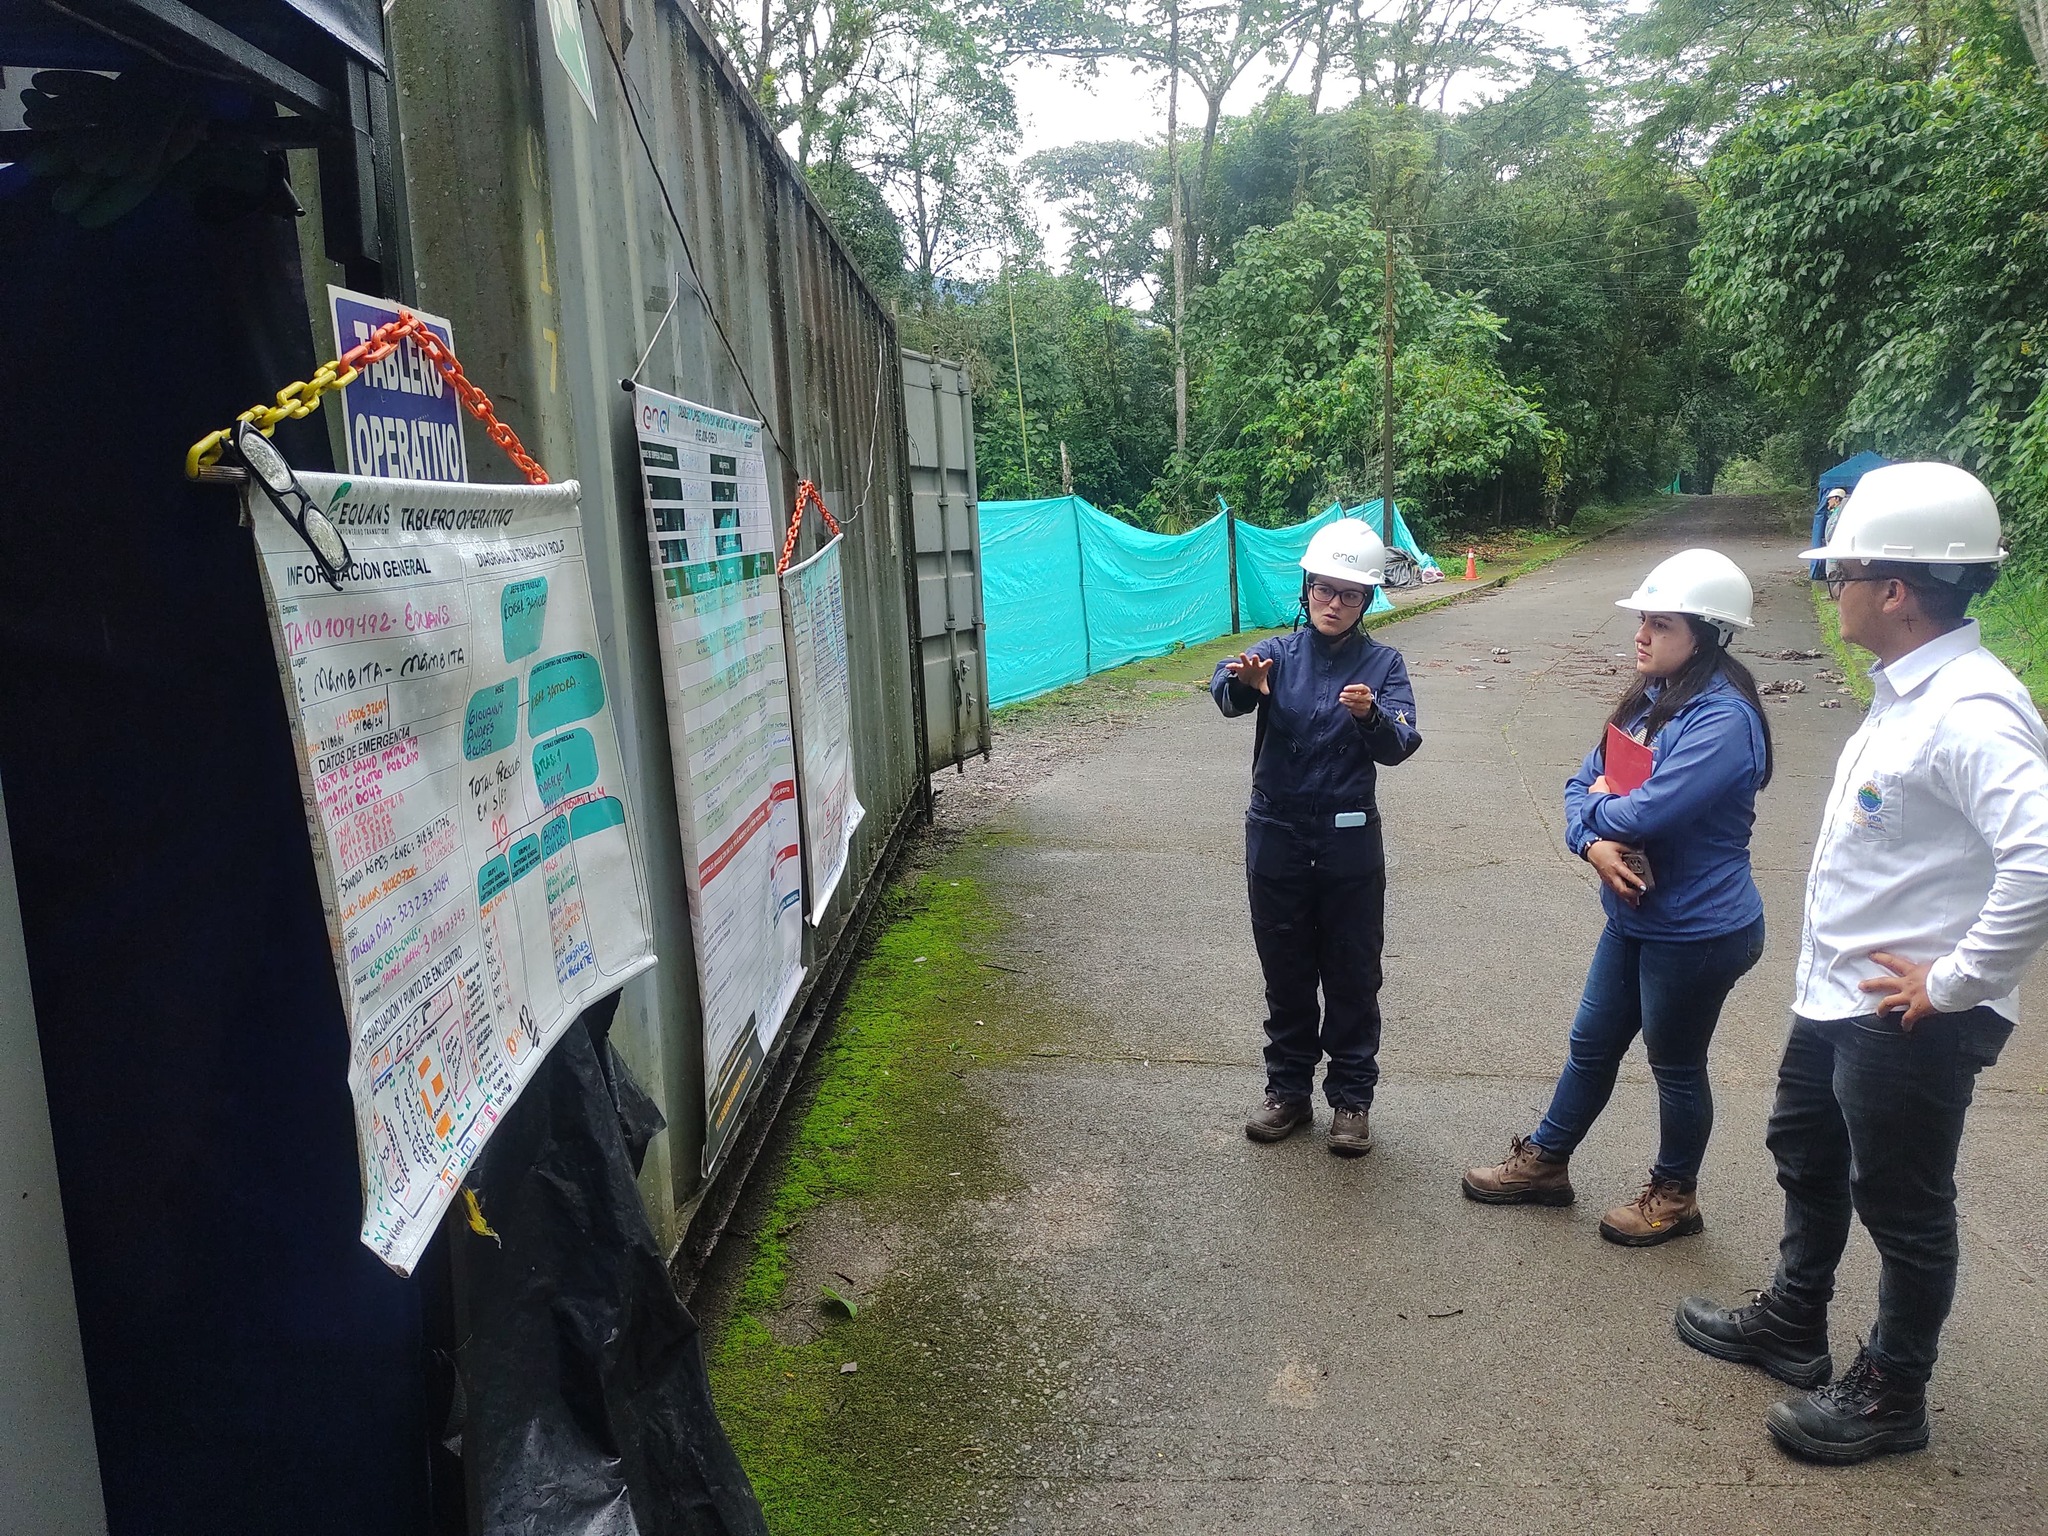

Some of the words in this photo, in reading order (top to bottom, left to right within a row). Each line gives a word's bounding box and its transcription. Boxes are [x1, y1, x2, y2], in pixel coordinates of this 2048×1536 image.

[354, 321, 444, 399] TABLERO
[642, 404, 672, 434] enel
[355, 413, 460, 482] OPERATIVO
[338, 502, 391, 526] EQUANS
[401, 507, 456, 531] TABLERO
[456, 508, 515, 530] OPERATIVO
[383, 558, 432, 579] GENERAL
[1332, 551, 1359, 564] enel
[292, 655, 308, 667] Lugar:
[319, 750, 346, 774] DATOS
[346, 744, 357, 762] DE
[358, 726, 411, 756] EMERGENCIA
[403, 985, 423, 1008] PUNTO
[422, 972, 434, 992] DE
[433, 945, 463, 984] ENCUENTRO
